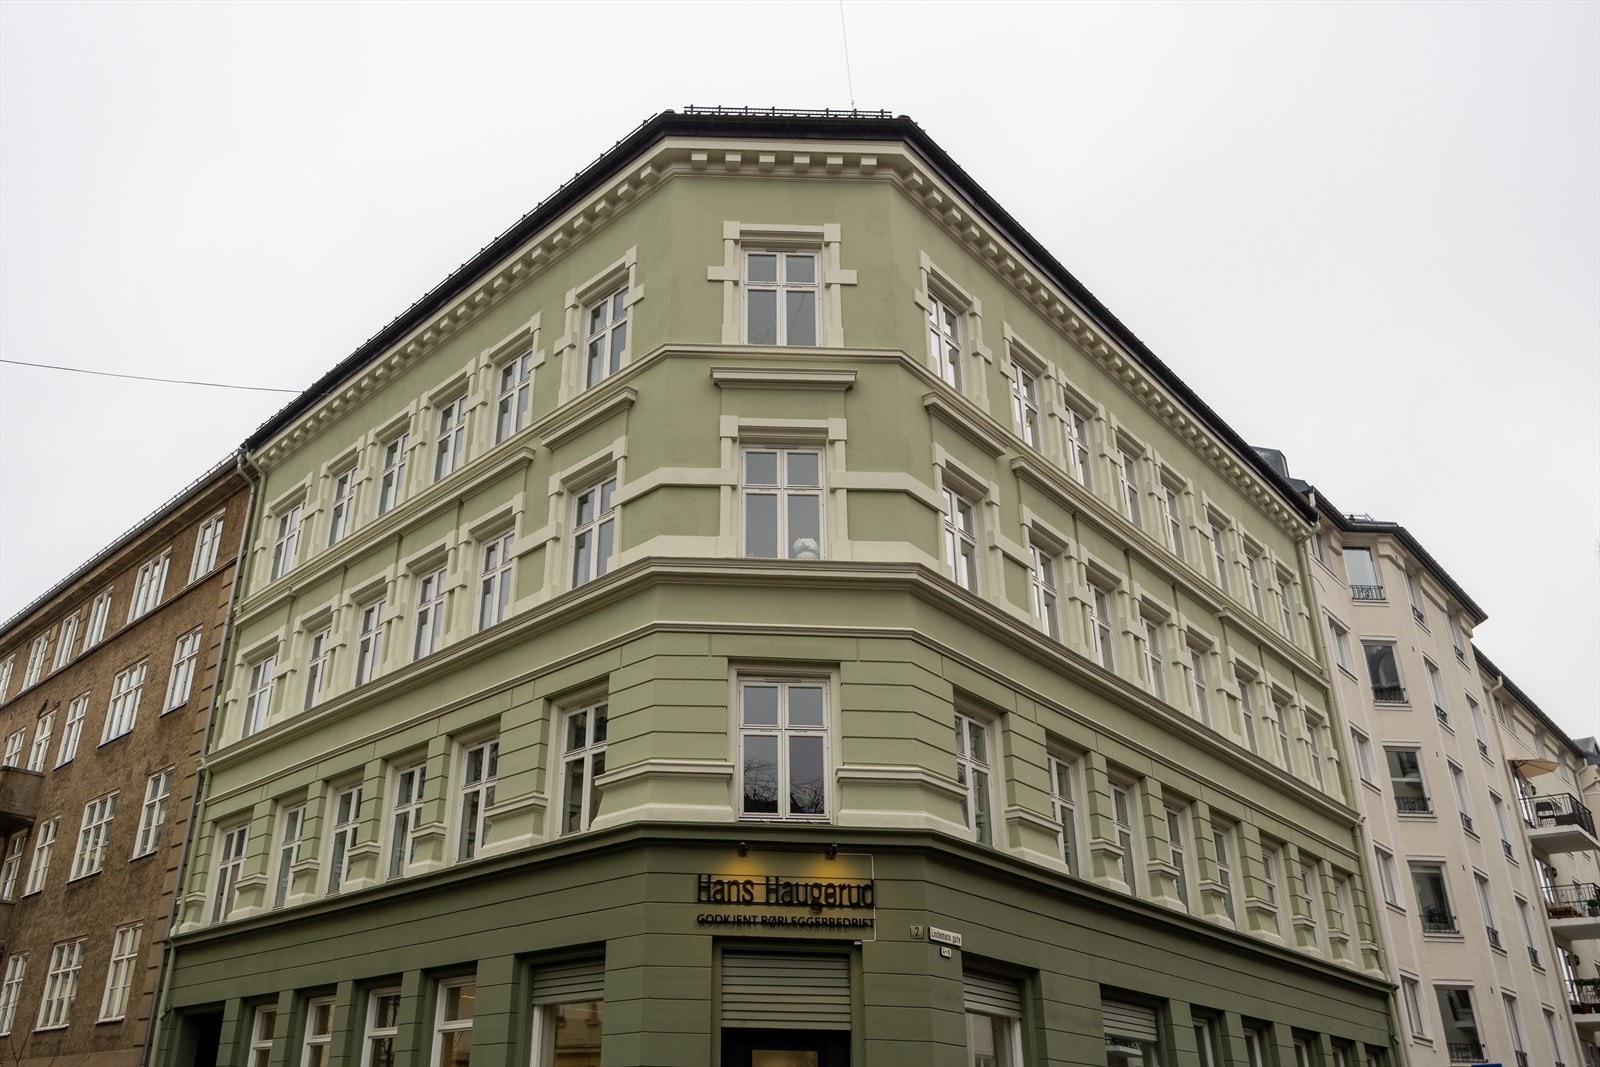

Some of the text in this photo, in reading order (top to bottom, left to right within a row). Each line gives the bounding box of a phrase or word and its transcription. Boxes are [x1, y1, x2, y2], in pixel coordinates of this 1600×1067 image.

[697, 873, 875, 913] Hans Haugerud
[697, 914, 758, 925] GODKJENT
[914, 926, 920, 937] 2
[931, 928, 961, 945] Lindemans gate
